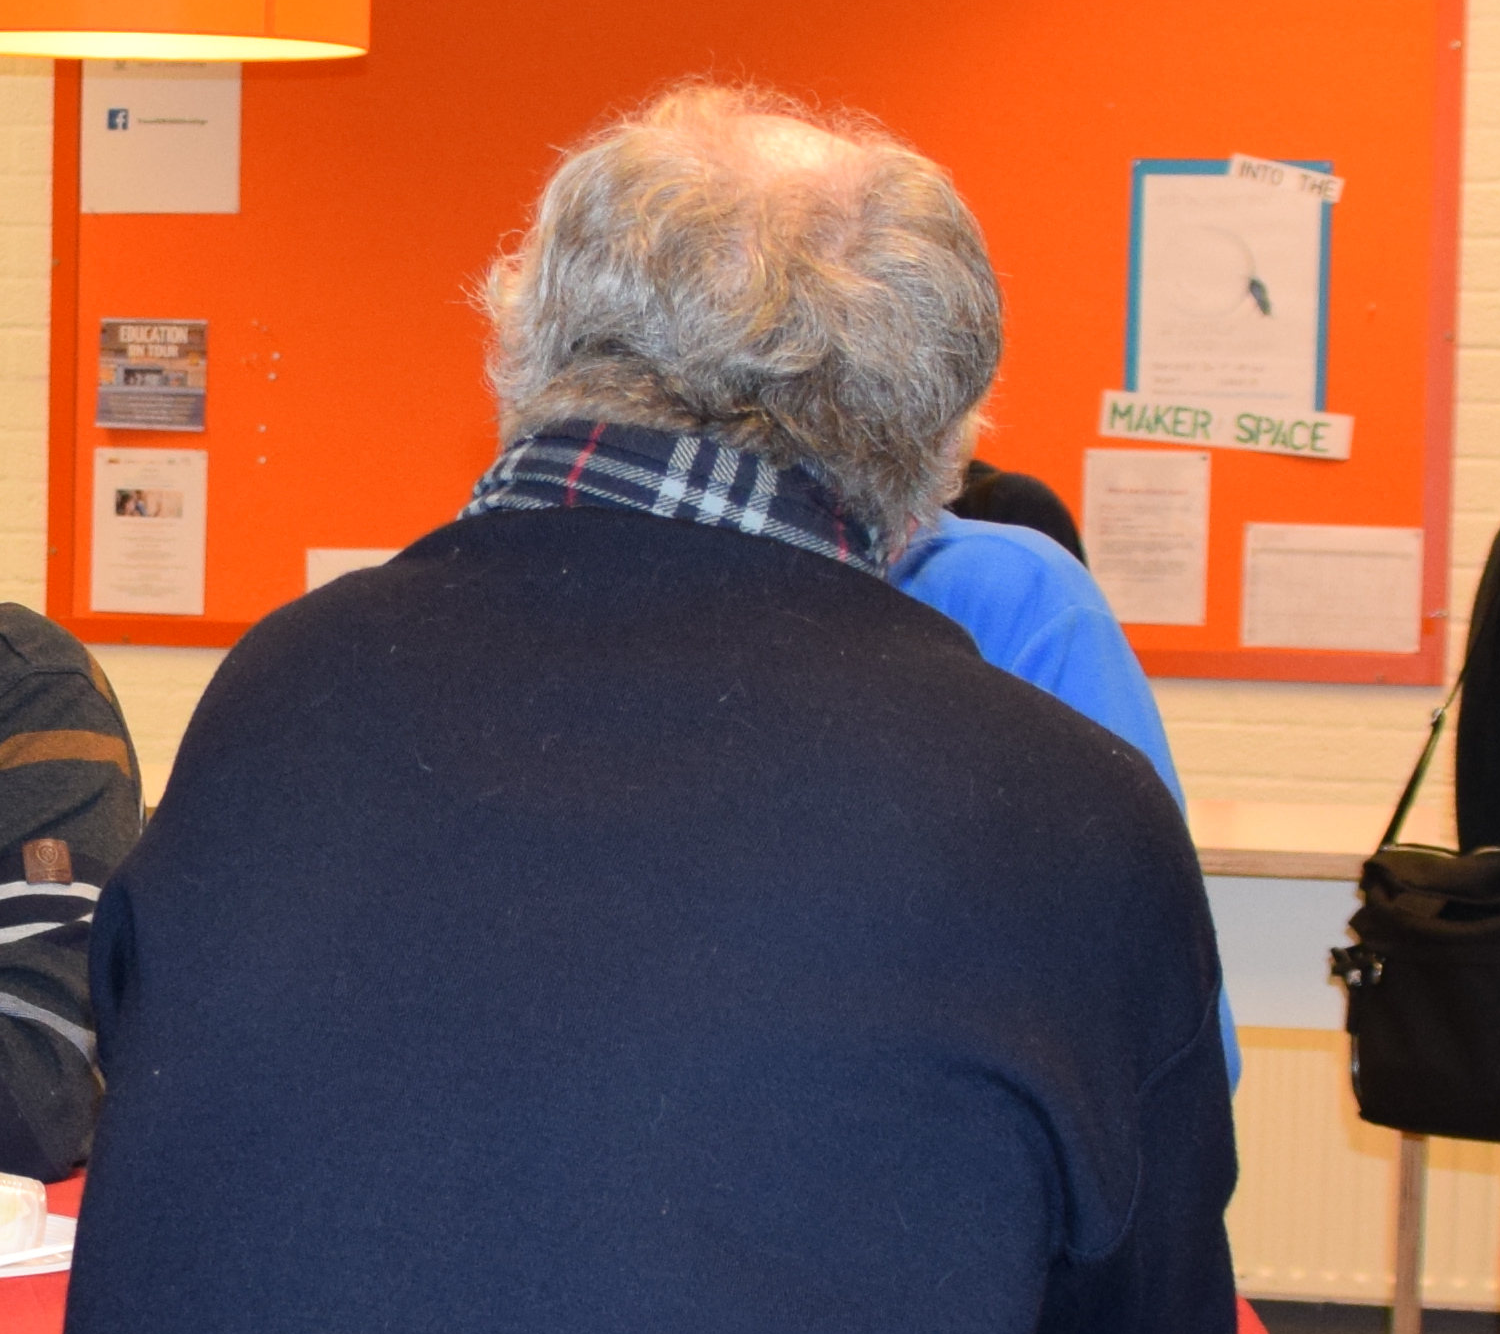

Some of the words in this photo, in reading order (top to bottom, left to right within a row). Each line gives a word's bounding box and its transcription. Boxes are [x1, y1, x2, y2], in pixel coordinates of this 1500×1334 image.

[1299, 173, 1339, 201] THE
[119, 325, 189, 344] EDUCATION
[148, 344, 178, 358] TOUR
[1109, 402, 1213, 440] MAKER
[1235, 412, 1332, 452] SPACE
